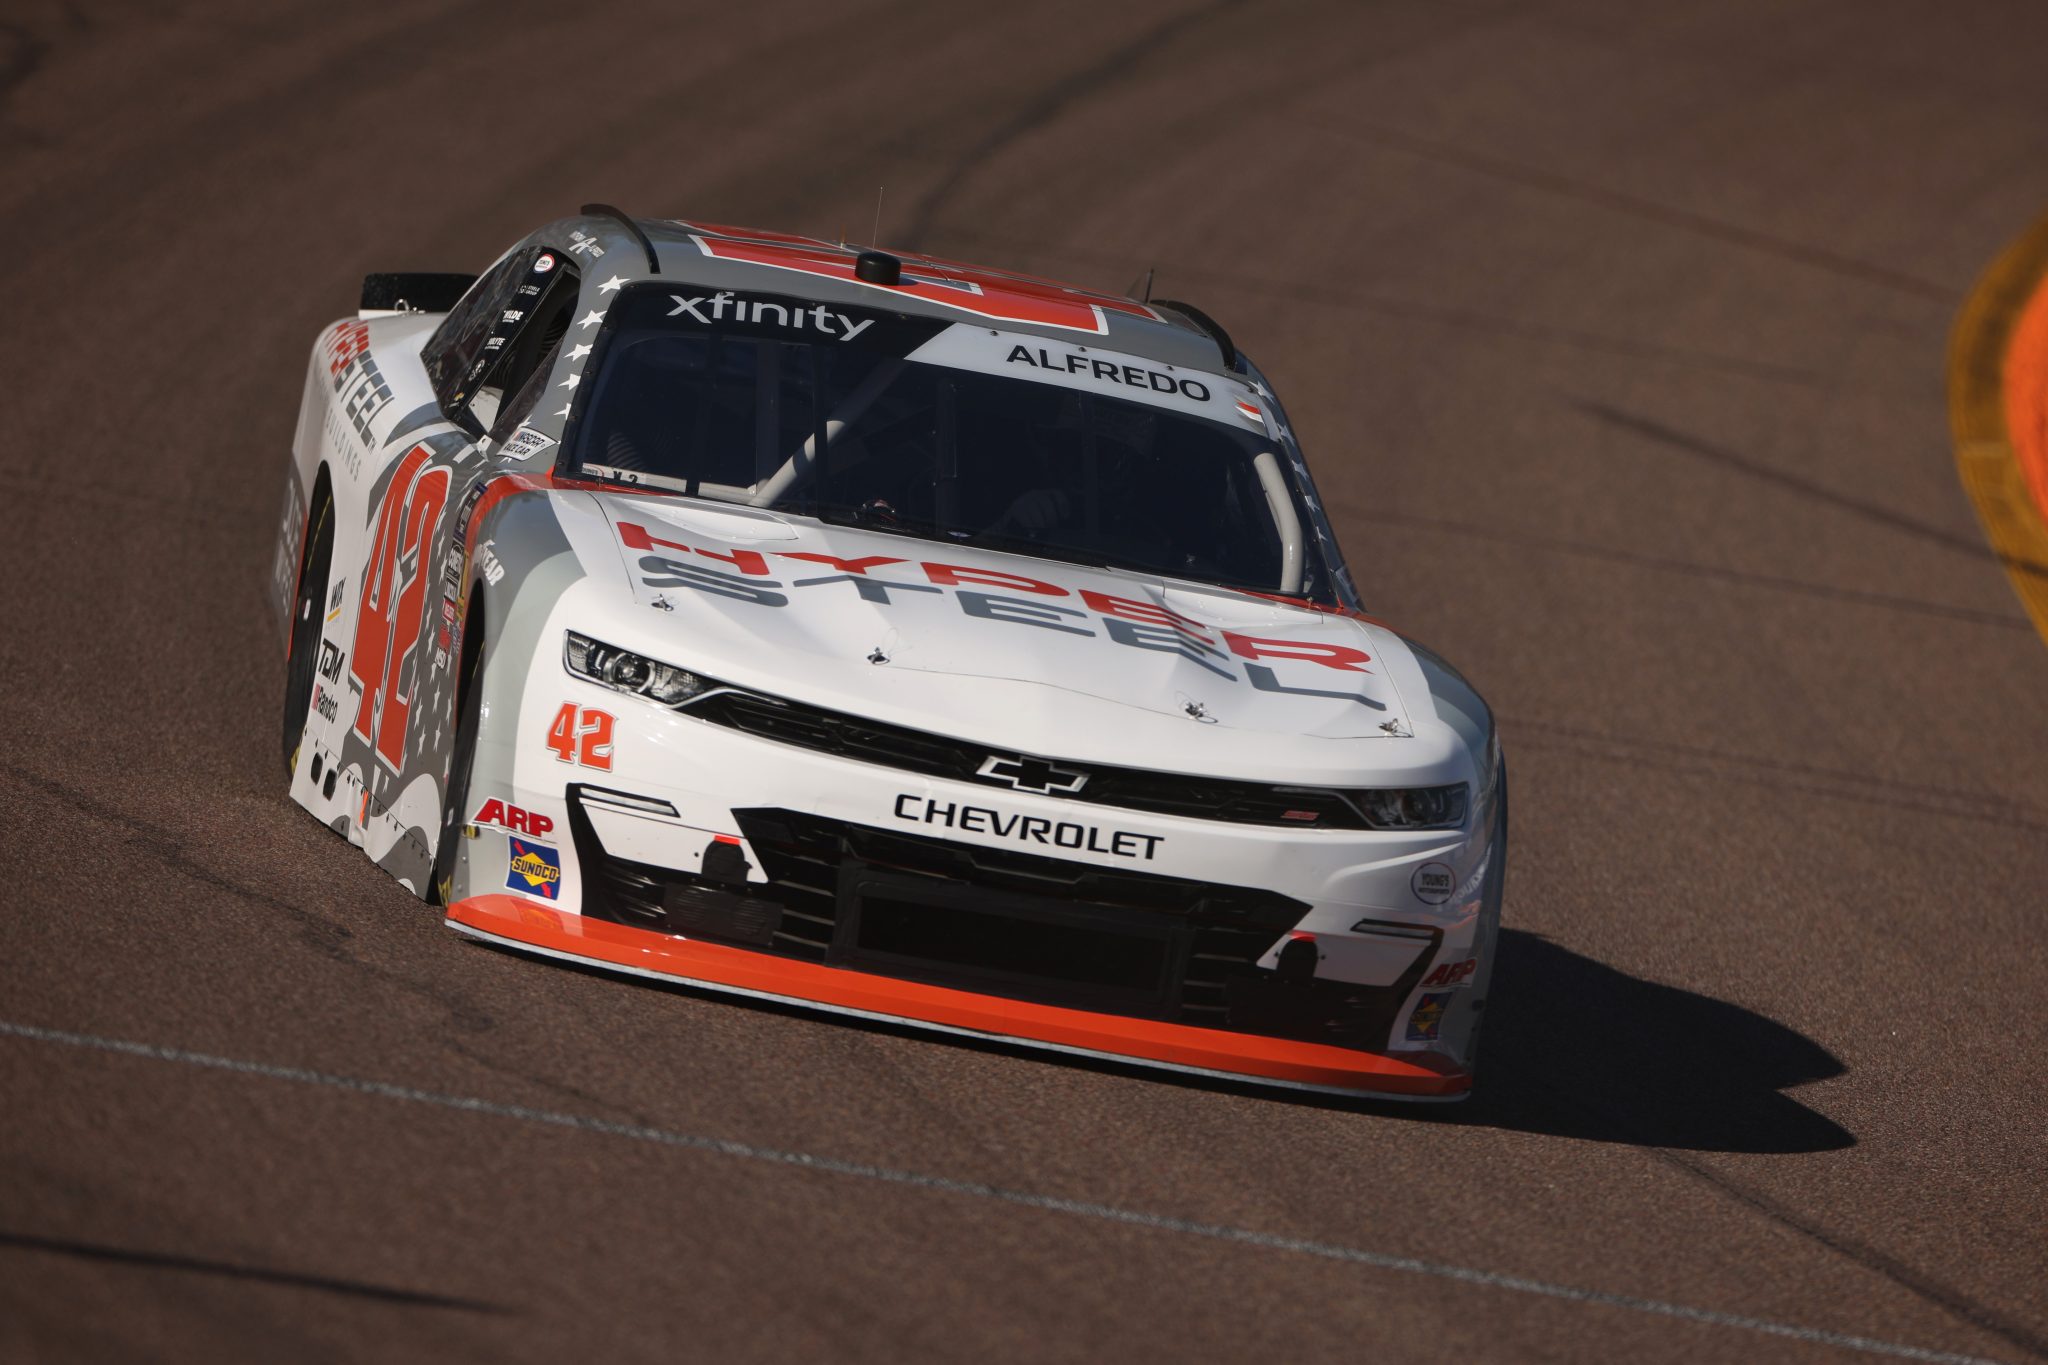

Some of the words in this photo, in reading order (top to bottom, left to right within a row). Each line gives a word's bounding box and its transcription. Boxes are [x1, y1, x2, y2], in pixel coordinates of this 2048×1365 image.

[666, 291, 876, 342] xfinity
[334, 350, 395, 448] STEEL
[1005, 344, 1212, 402] ALFREDO
[349, 442, 453, 778] 42
[616, 521, 1374, 675] HYPER
[638, 555, 1387, 712] STEEL
[546, 700, 619, 773] 42
[474, 798, 554, 837] ARP
[894, 794, 1165, 860] CHEVROLET
[512, 857, 558, 882] SUNOCO
[1422, 958, 1477, 985] ARP
